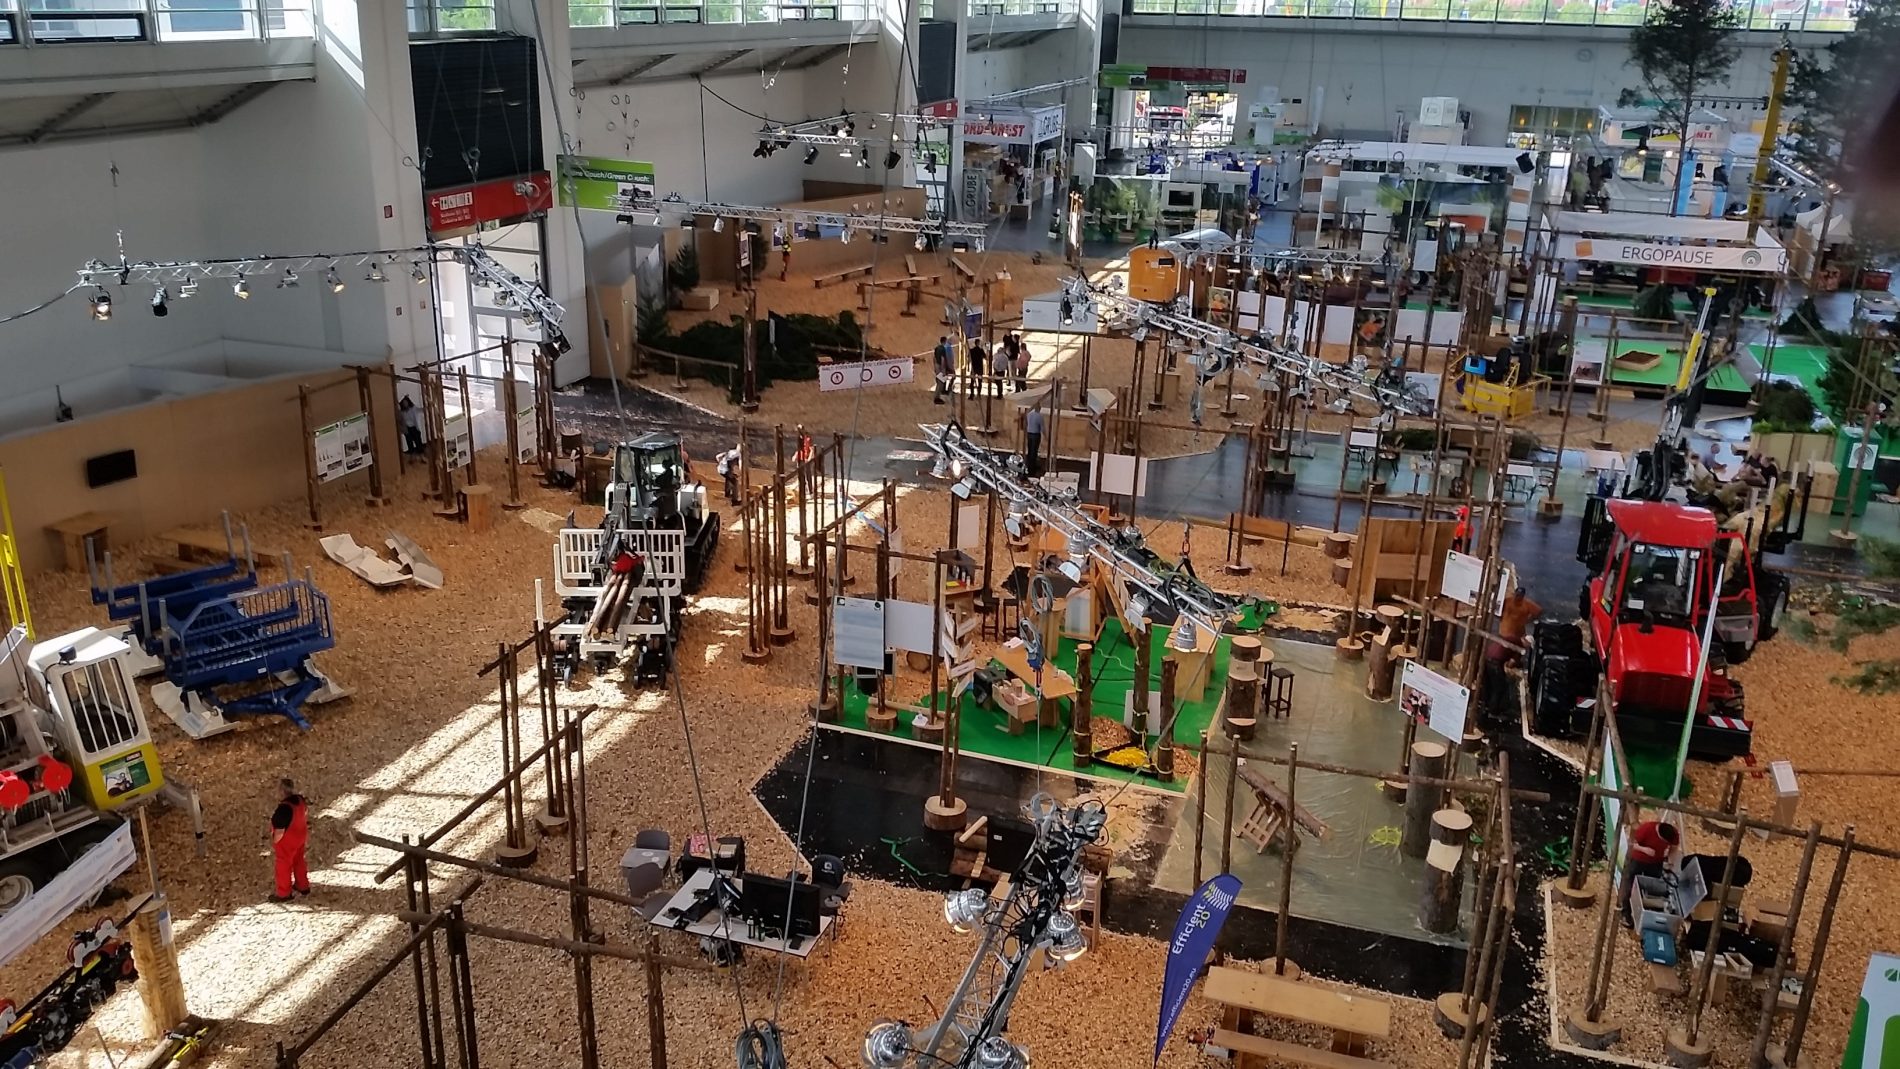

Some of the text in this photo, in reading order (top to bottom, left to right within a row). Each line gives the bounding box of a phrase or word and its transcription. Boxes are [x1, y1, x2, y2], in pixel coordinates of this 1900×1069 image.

[966, 175, 977, 208] GRUBE
[1621, 246, 1714, 265] ERGOPAUSE
[1172, 903, 1206, 955] Efficient
[1195, 911, 1211, 929] 20
